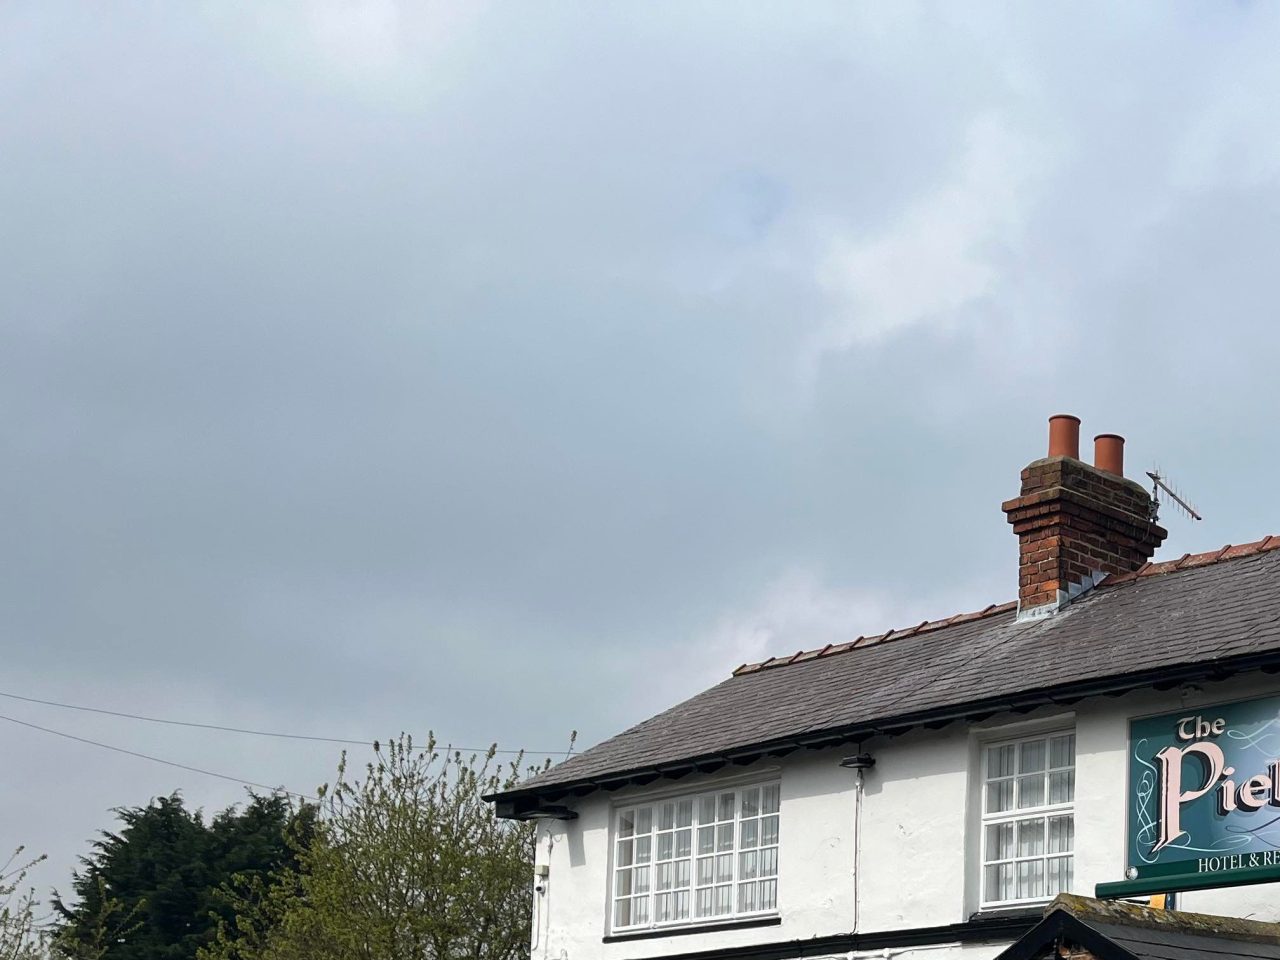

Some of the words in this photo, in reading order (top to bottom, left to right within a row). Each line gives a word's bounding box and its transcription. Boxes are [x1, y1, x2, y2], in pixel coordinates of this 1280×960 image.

[1176, 715, 1226, 742] The
[1198, 855, 1247, 873] HOTEL
[1249, 852, 1260, 867] &
